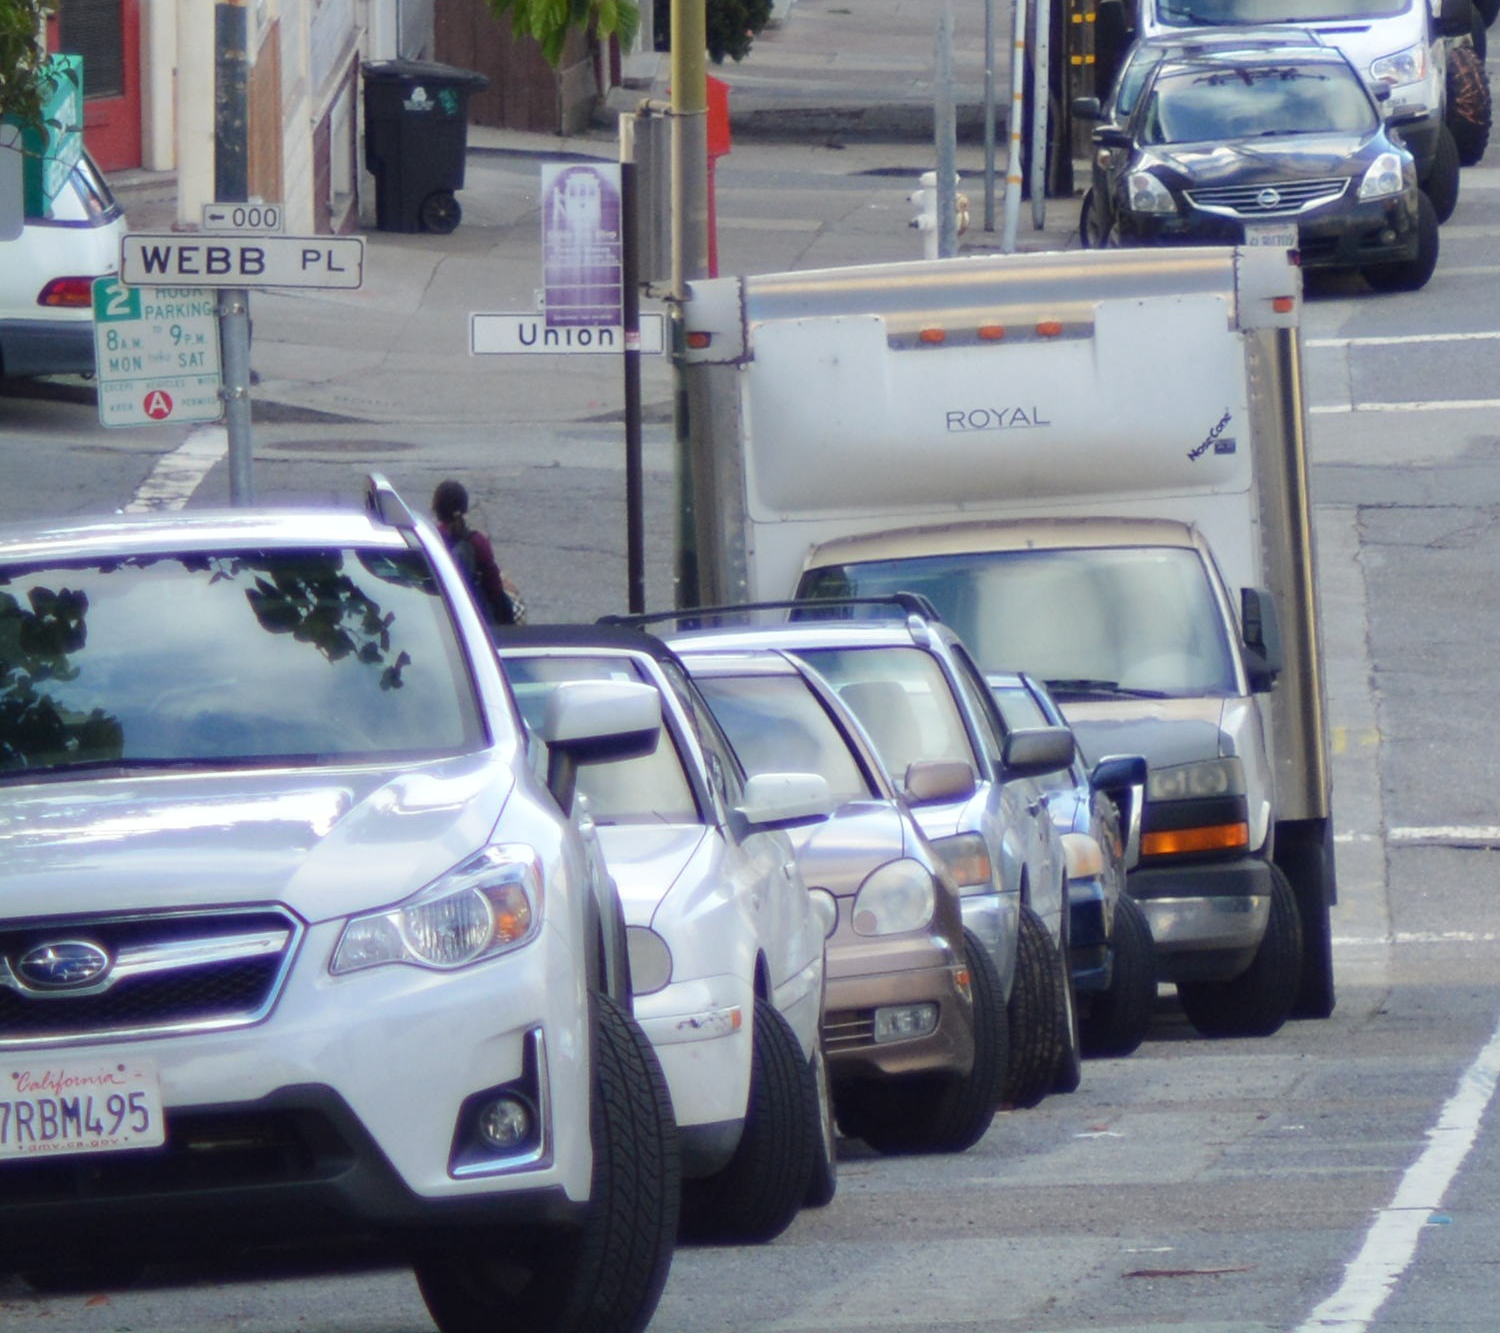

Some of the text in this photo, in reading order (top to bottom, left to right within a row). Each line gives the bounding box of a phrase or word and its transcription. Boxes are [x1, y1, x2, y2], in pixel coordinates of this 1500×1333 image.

[231, 207, 278, 228] 000
[141, 245, 346, 275] WEBB PL
[104, 288, 131, 316] 2
[144, 300, 212, 321] PARKING
[518, 322, 614, 346] Union
[109, 358, 143, 373] MON
[177, 351, 205, 368] SAT
[146, 390, 169, 416] A
[946, 406, 1051, 430] ROYAL
[16, 1069, 126, 1095] California
[0, 1090, 149, 1144] 7RBM495
